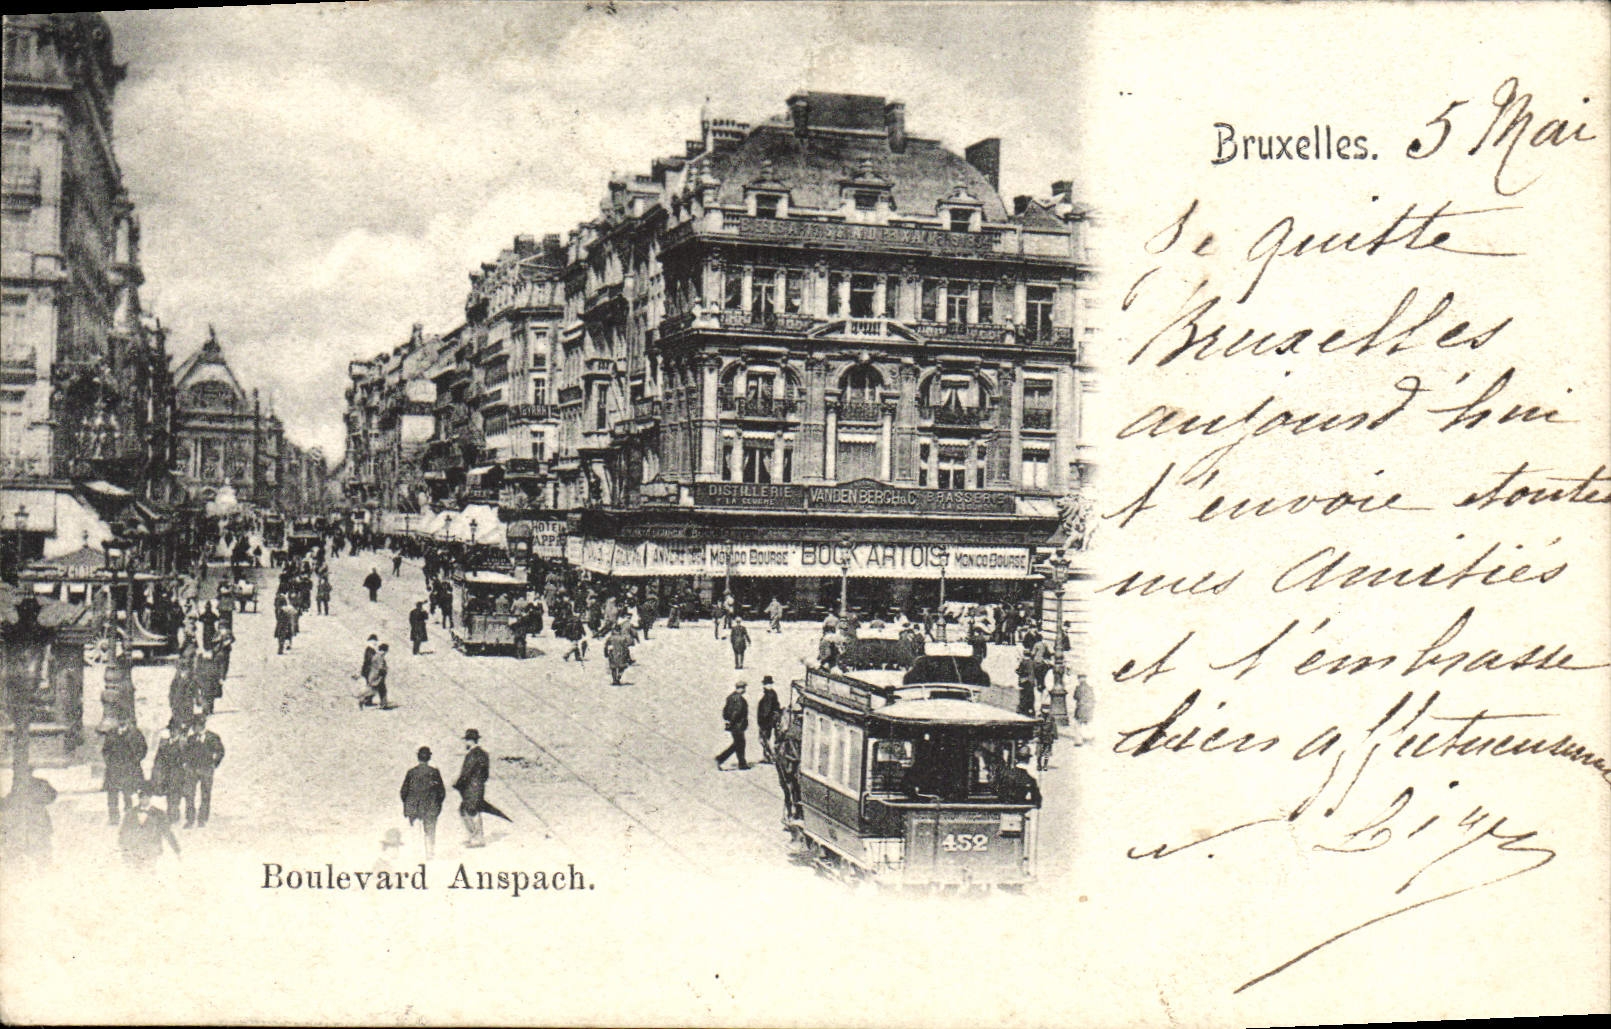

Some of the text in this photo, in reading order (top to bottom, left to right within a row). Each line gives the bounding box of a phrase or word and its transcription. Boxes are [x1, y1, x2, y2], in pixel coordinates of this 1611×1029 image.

[1407, 77, 1597, 196] 5 Mai
[1237, 196, 1526, 304] quitte
[1128, 286, 1514, 367] Bruxelles
[708, 485, 792, 498] DISTILLERIE
[1112, 630, 1196, 683] et
[941, 833, 988, 852] 452
